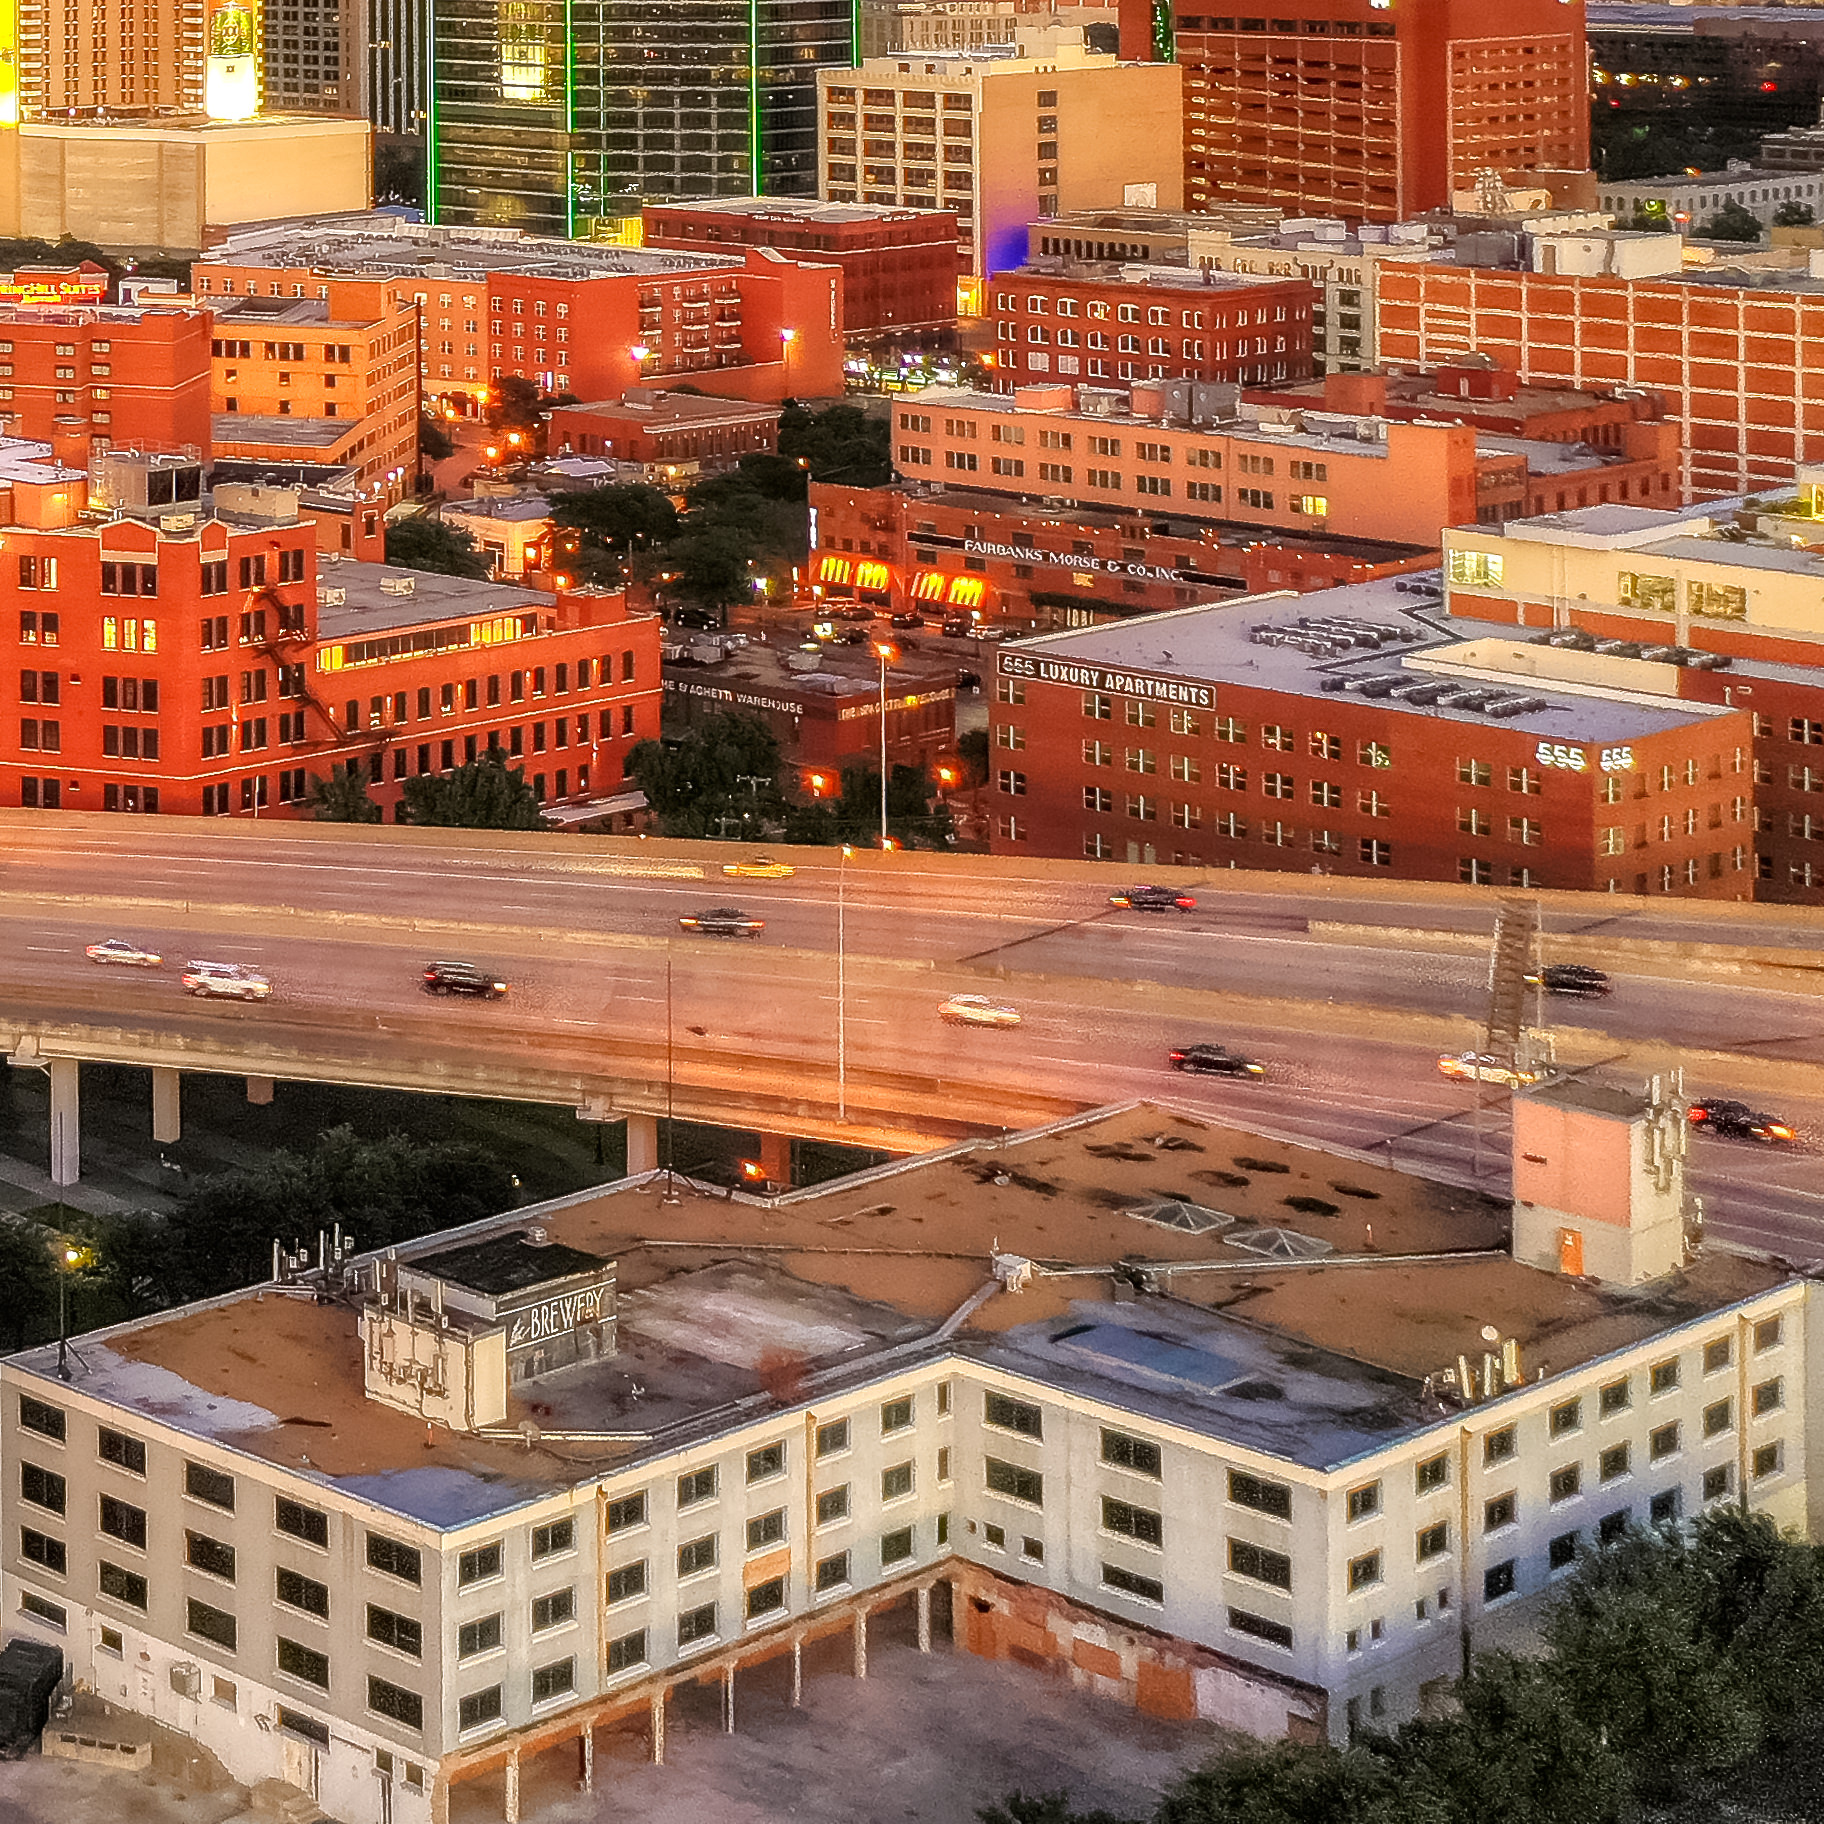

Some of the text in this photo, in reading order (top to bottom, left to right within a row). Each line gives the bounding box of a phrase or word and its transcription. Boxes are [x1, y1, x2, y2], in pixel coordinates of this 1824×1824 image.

[964, 540, 1045, 561] FAIRBANKS
[1050, 551, 1100, 570] MORSE
[1107, 559, 1120, 572] &
[662, 679, 675, 690] HE
[737, 693, 803, 714] WAREHOUSE
[1003, 657, 1209, 706] 555 LUXURY APARTMENTS
[1535, 742, 1586, 771] 555
[1600, 746, 1633, 771] 555
[531, 1288, 604, 1339] BREWERY
